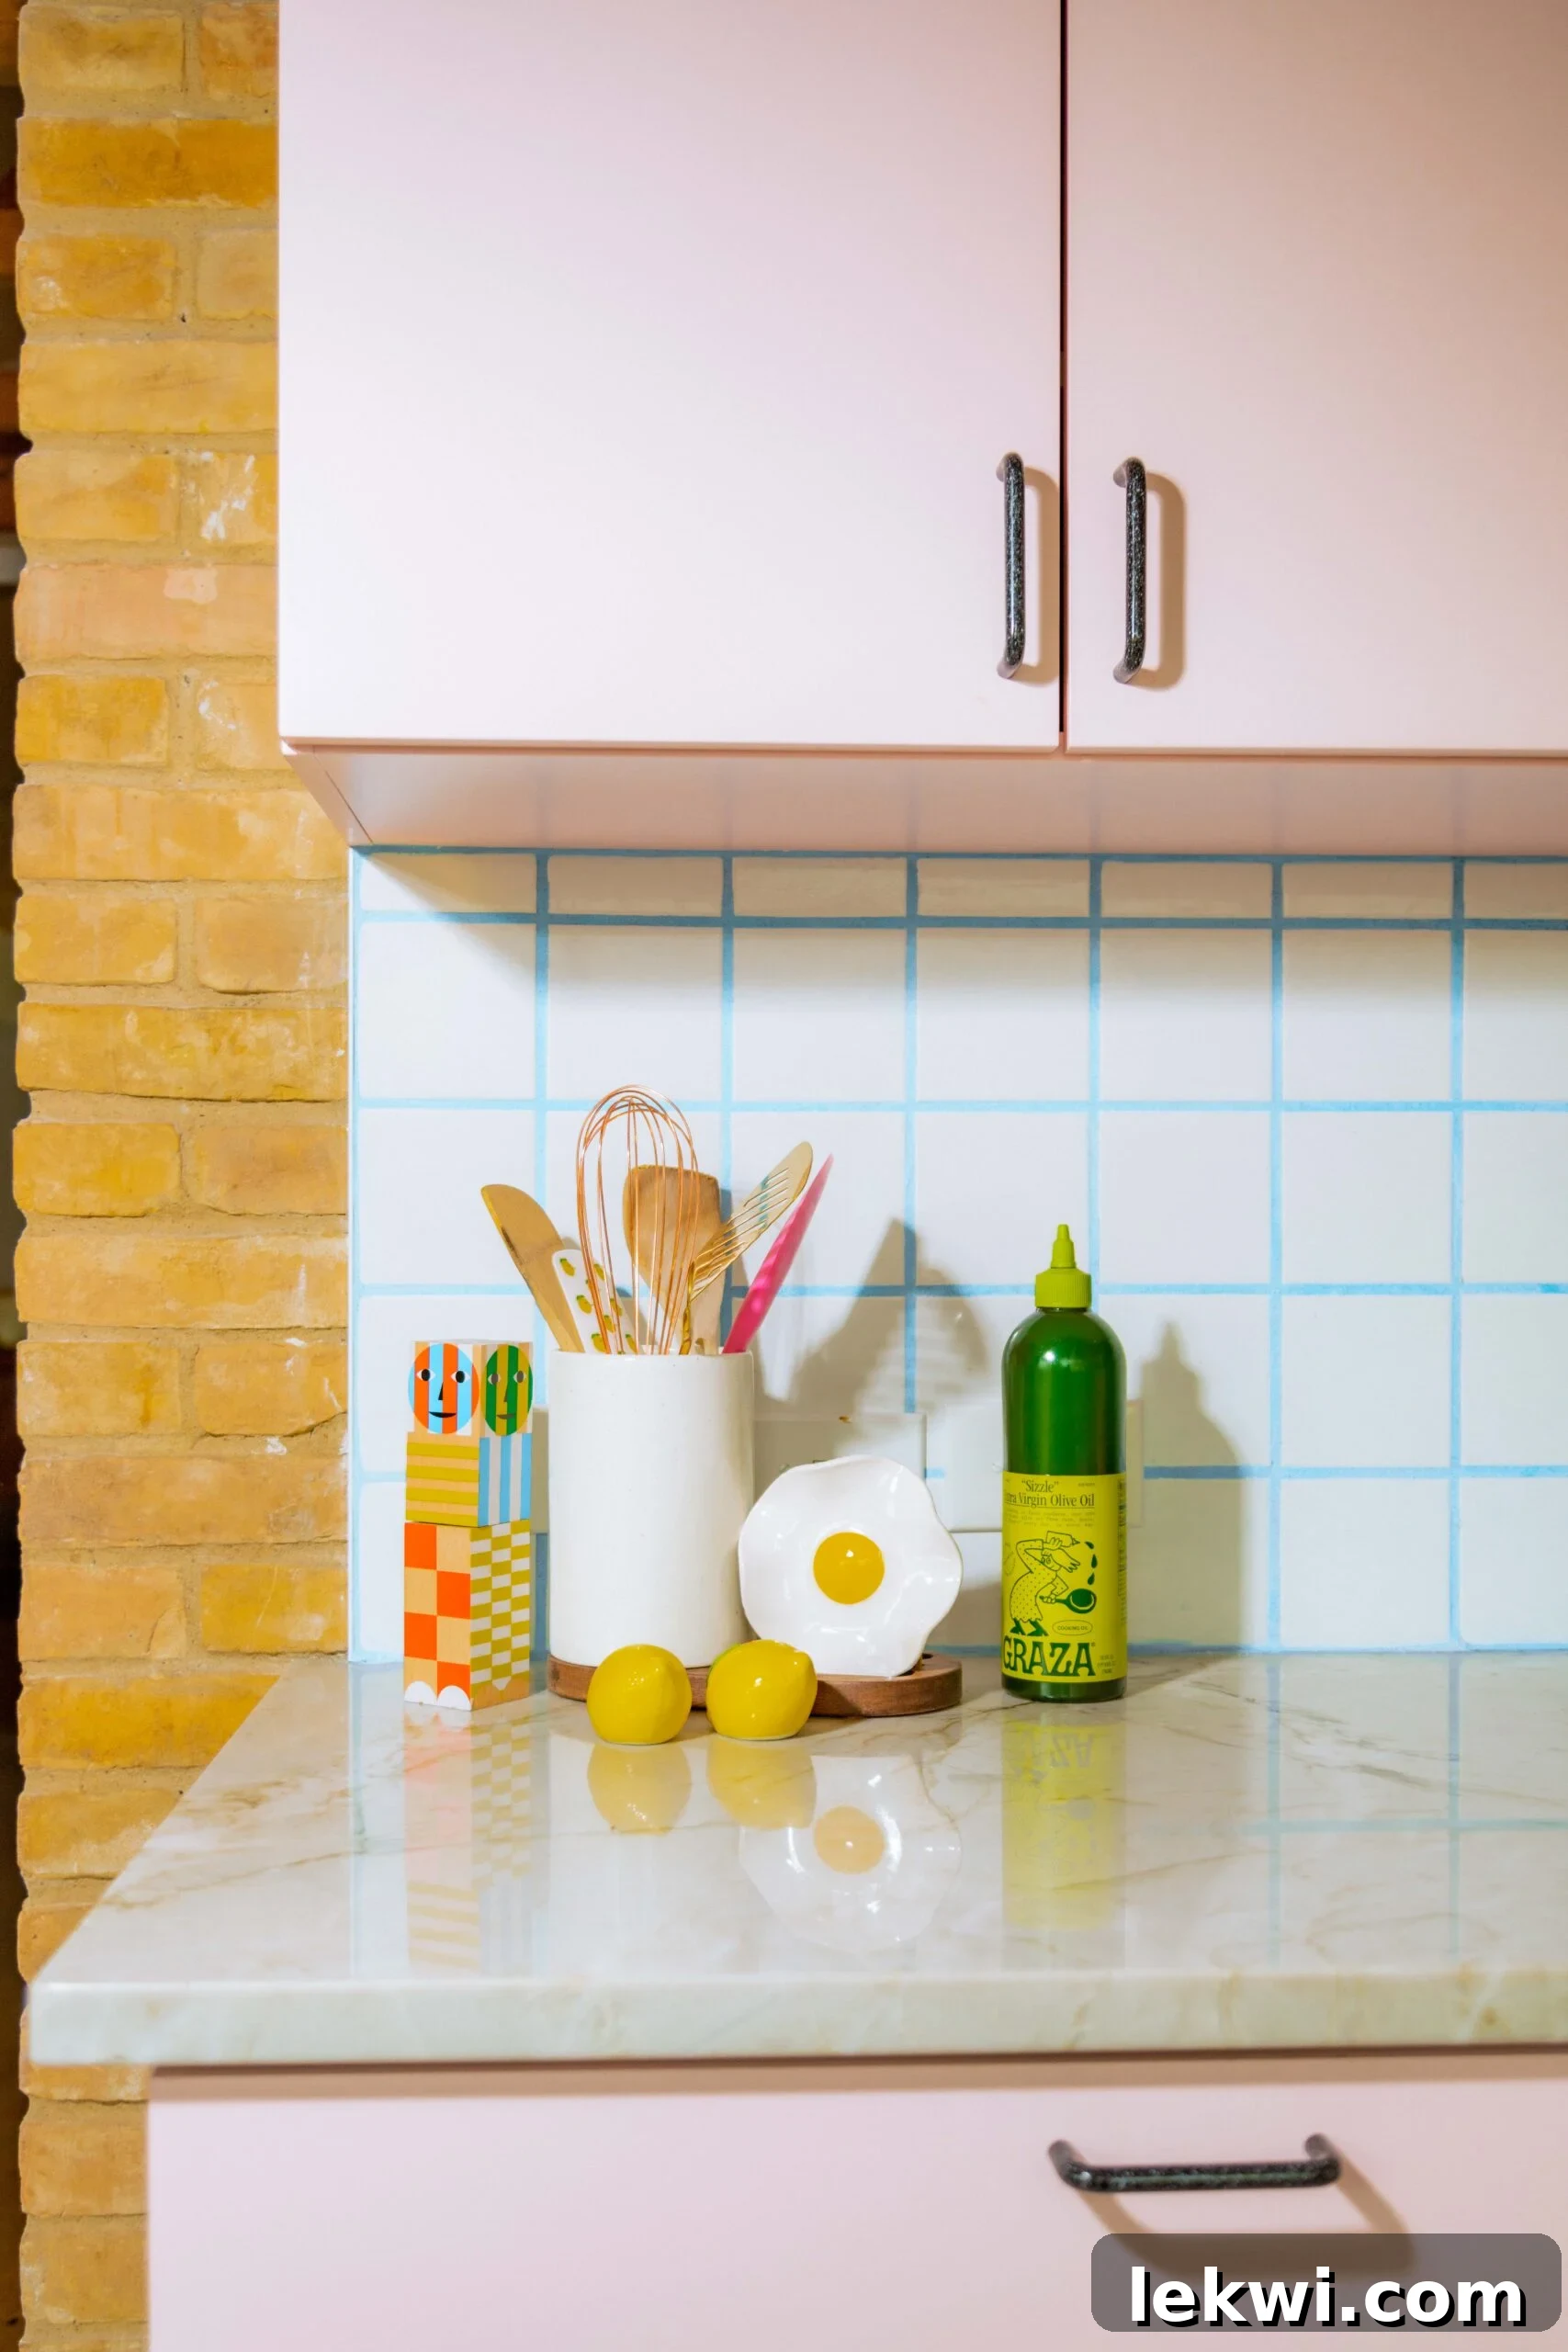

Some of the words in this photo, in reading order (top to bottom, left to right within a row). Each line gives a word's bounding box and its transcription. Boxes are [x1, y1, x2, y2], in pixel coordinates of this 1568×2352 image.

[1018, 1491, 1047, 1508] Virgin
[1050, 1493, 1077, 1507] Olive
[1079, 1493, 1095, 1507] Oil
[1003, 1635, 1096, 1677] GRAZA
